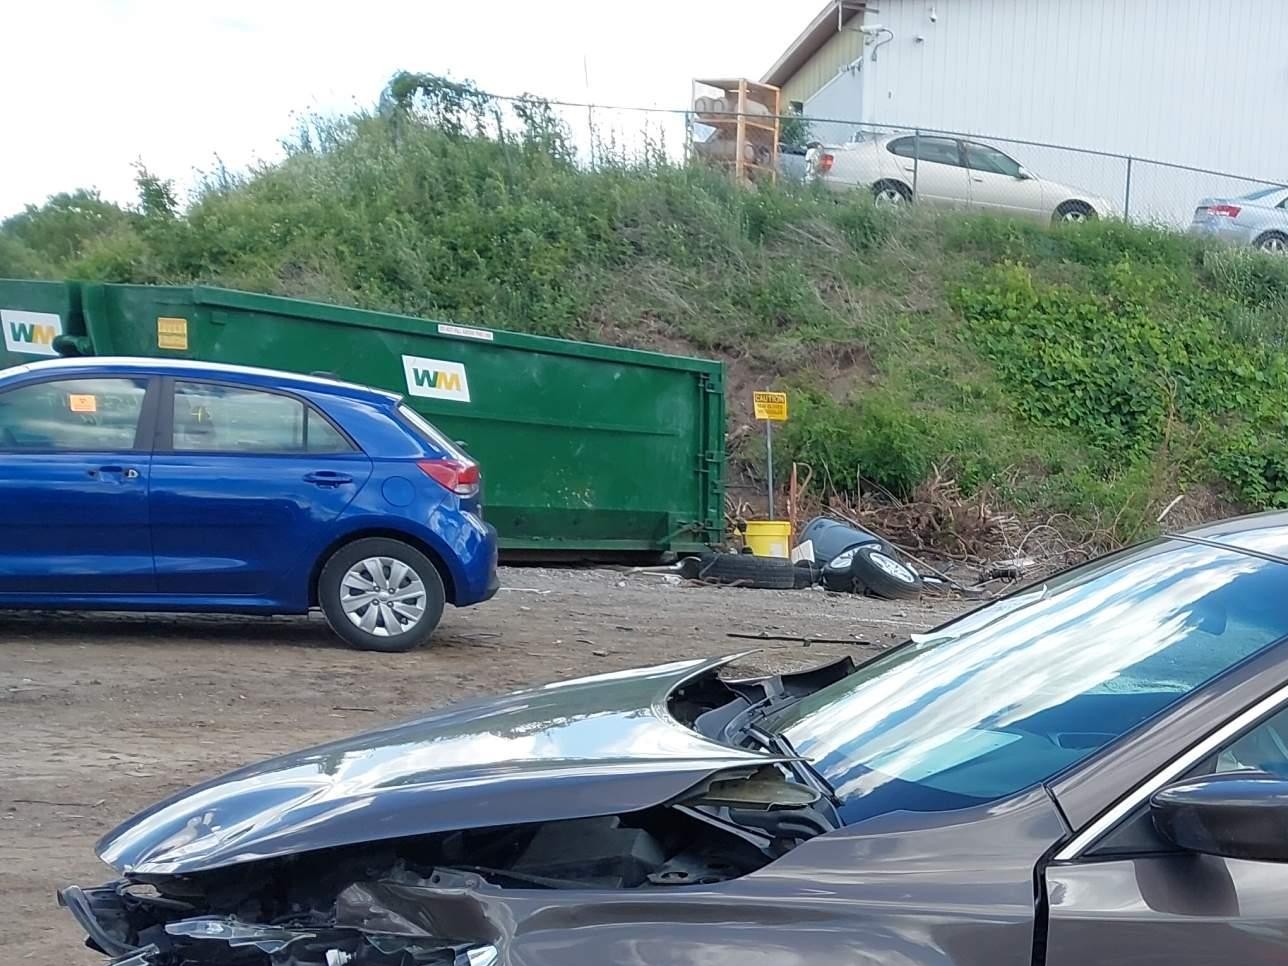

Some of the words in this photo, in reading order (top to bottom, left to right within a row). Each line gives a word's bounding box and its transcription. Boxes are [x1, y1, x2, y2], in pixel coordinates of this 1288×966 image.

[10, 322, 56, 345] WM
[412, 367, 461, 392] WM
[755, 394, 784, 403] CAUTION
